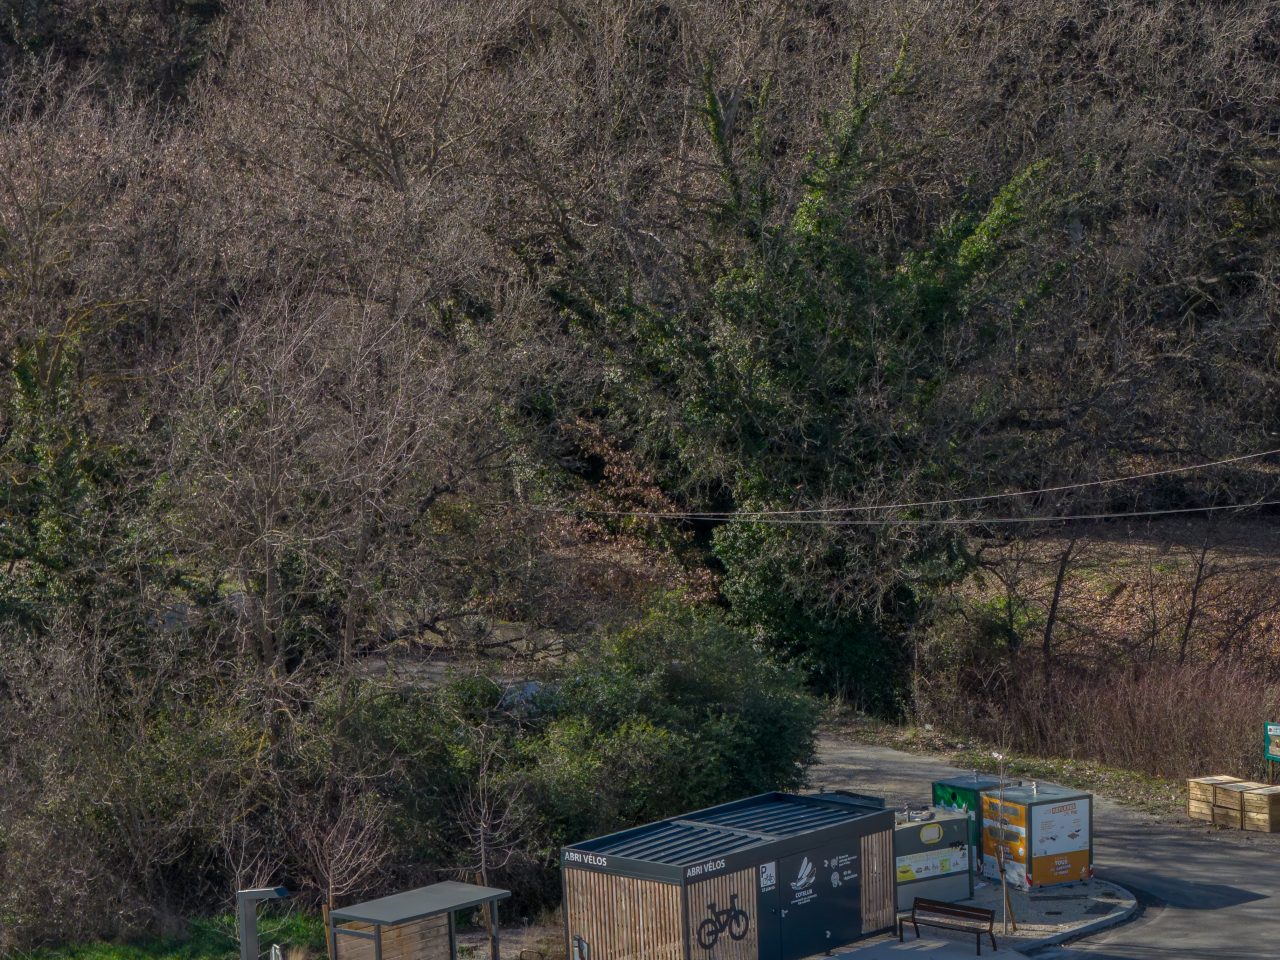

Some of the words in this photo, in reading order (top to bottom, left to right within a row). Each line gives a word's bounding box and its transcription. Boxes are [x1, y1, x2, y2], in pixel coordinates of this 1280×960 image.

[564, 851, 582, 863] ABRI
[583, 854, 607, 867] VÉLOS
[686, 866, 703, 878] ABRI
[703, 858, 726, 873] VÉLOS
